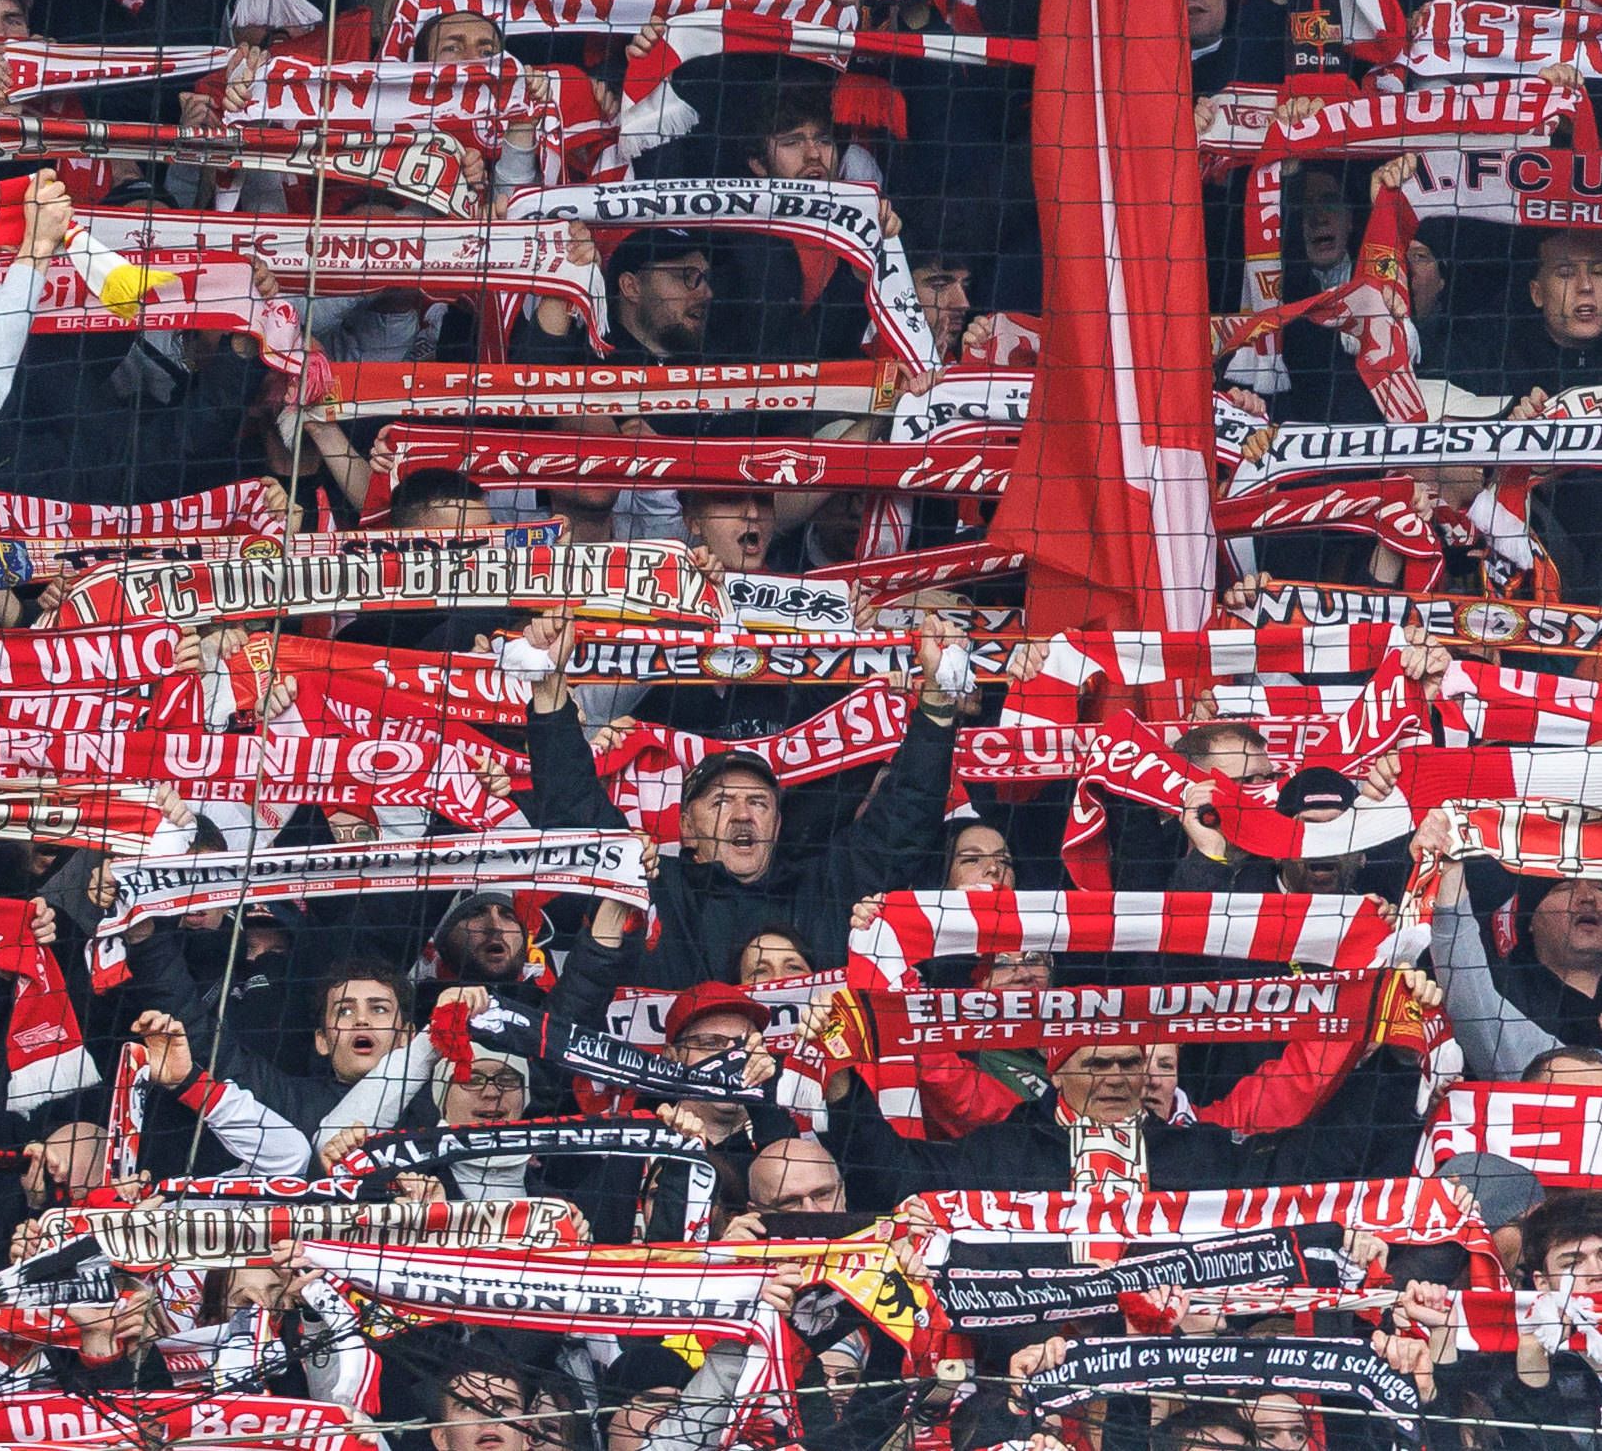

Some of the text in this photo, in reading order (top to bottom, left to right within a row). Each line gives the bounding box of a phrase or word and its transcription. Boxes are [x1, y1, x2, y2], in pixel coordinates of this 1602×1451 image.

[1294, 50, 1340, 69] Berlin
[1278, 77, 1579, 143] UNIONER
[654, 178, 698, 195] erst
[704, 177, 765, 193] recht
[775, 178, 817, 195] zum
[1461, 151, 1553, 194] FC
[596, 192, 764, 221] UNION
[231, 231, 428, 261] FC UNION
[269, 255, 416, 271] VON DER ALTEN
[458, 363, 820, 389] FC UNION BERLIN
[123, 543, 610, 618] FC UNION BERLIN
[206, 780, 358, 805] DER WUHLE
[405, 843, 624, 873] ROT-WEISS
[287, 873, 581, 894] EISERN EISERN EISERN EISERN
[905, 983, 1340, 1024] EISERN UNION
[896, 1019, 1016, 1046] JETZT
[1040, 1018, 1141, 1038] ERST
[1166, 1017, 1292, 1036] RECHT
[568, 1031, 686, 1079] Leckt uns doch
[90, 1203, 500, 1263] UNION BERLIN
[457, 1270, 502, 1287] erst
[506, 1274, 569, 1293] recht
[573, 1280, 623, 1297] zum
[948, 1241, 1295, 1314] doch am Ihr keine Unioner seid
[1081, 1342, 1340, 1377] wird es wagen uns zu
